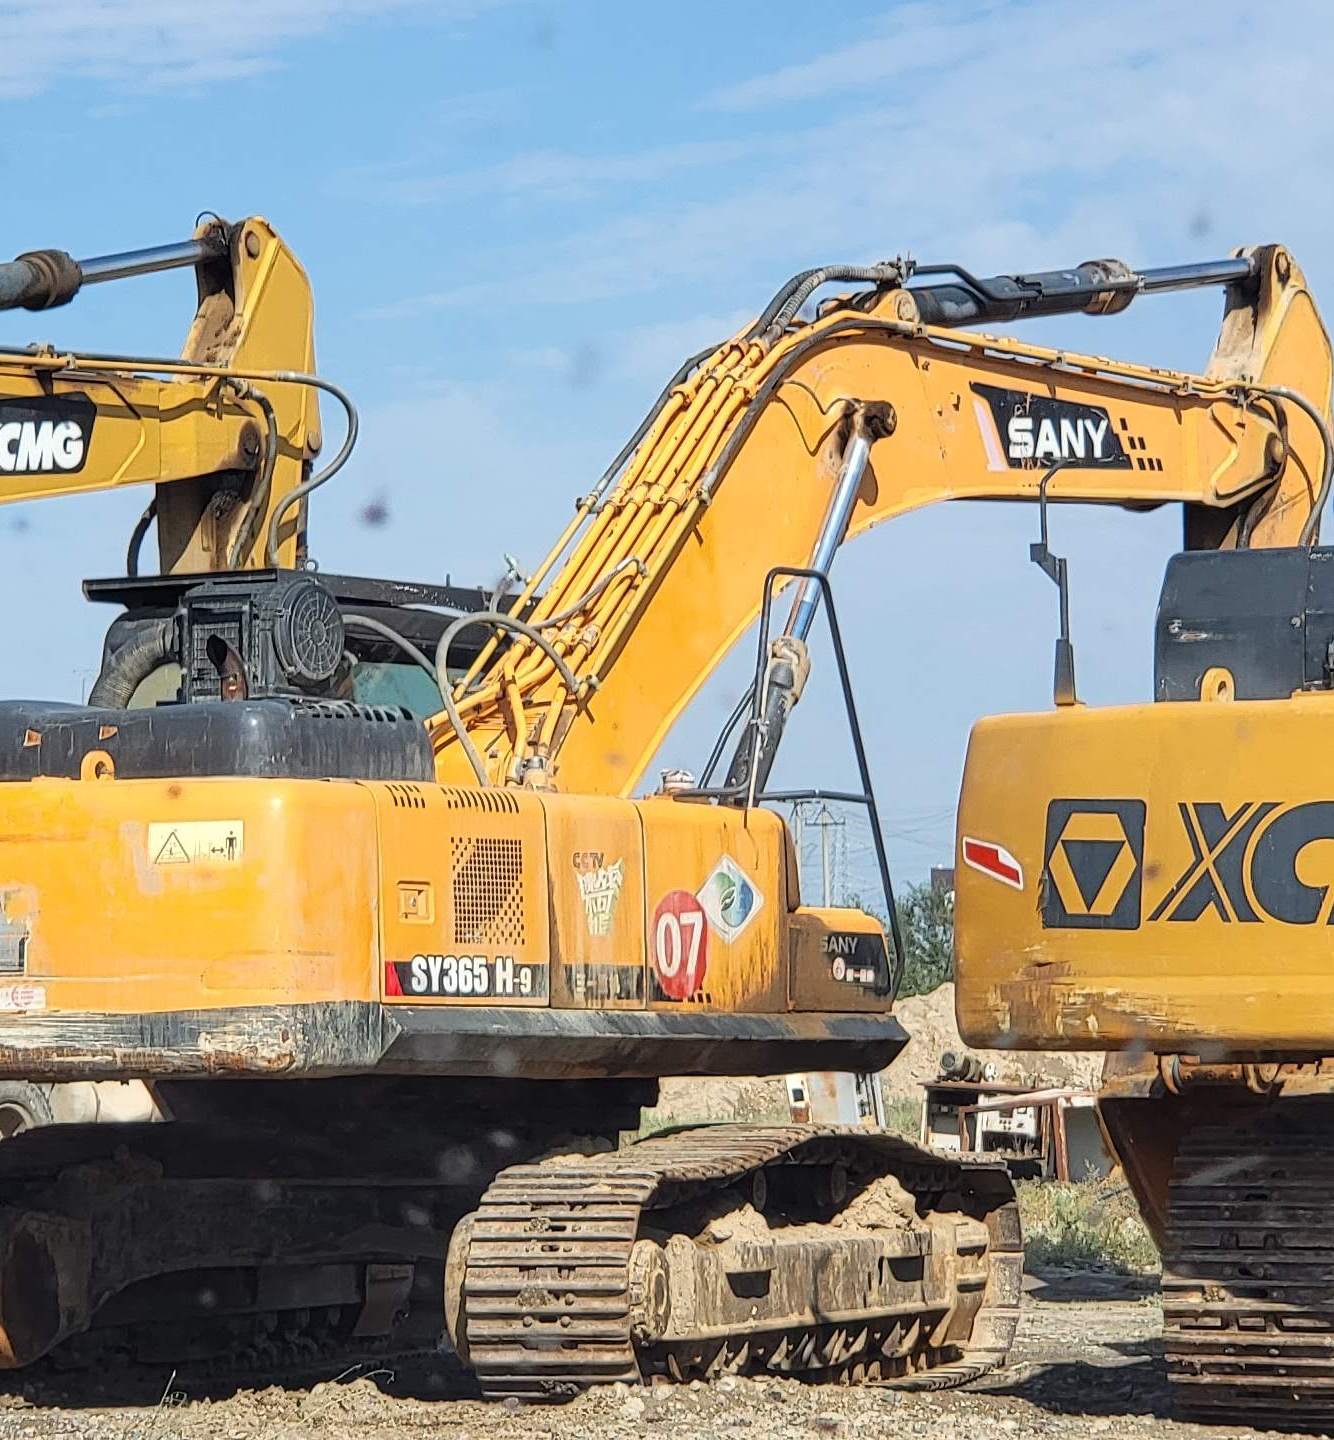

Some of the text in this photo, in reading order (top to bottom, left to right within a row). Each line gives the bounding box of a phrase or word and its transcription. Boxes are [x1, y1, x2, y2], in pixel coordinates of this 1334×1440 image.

[1008, 416, 1109, 458] SANY
[572, 852, 604, 869] CCTV
[656, 911, 703, 998] 07
[820, 935, 858, 954] SANY
[410, 955, 532, 995] SY365 H-9
